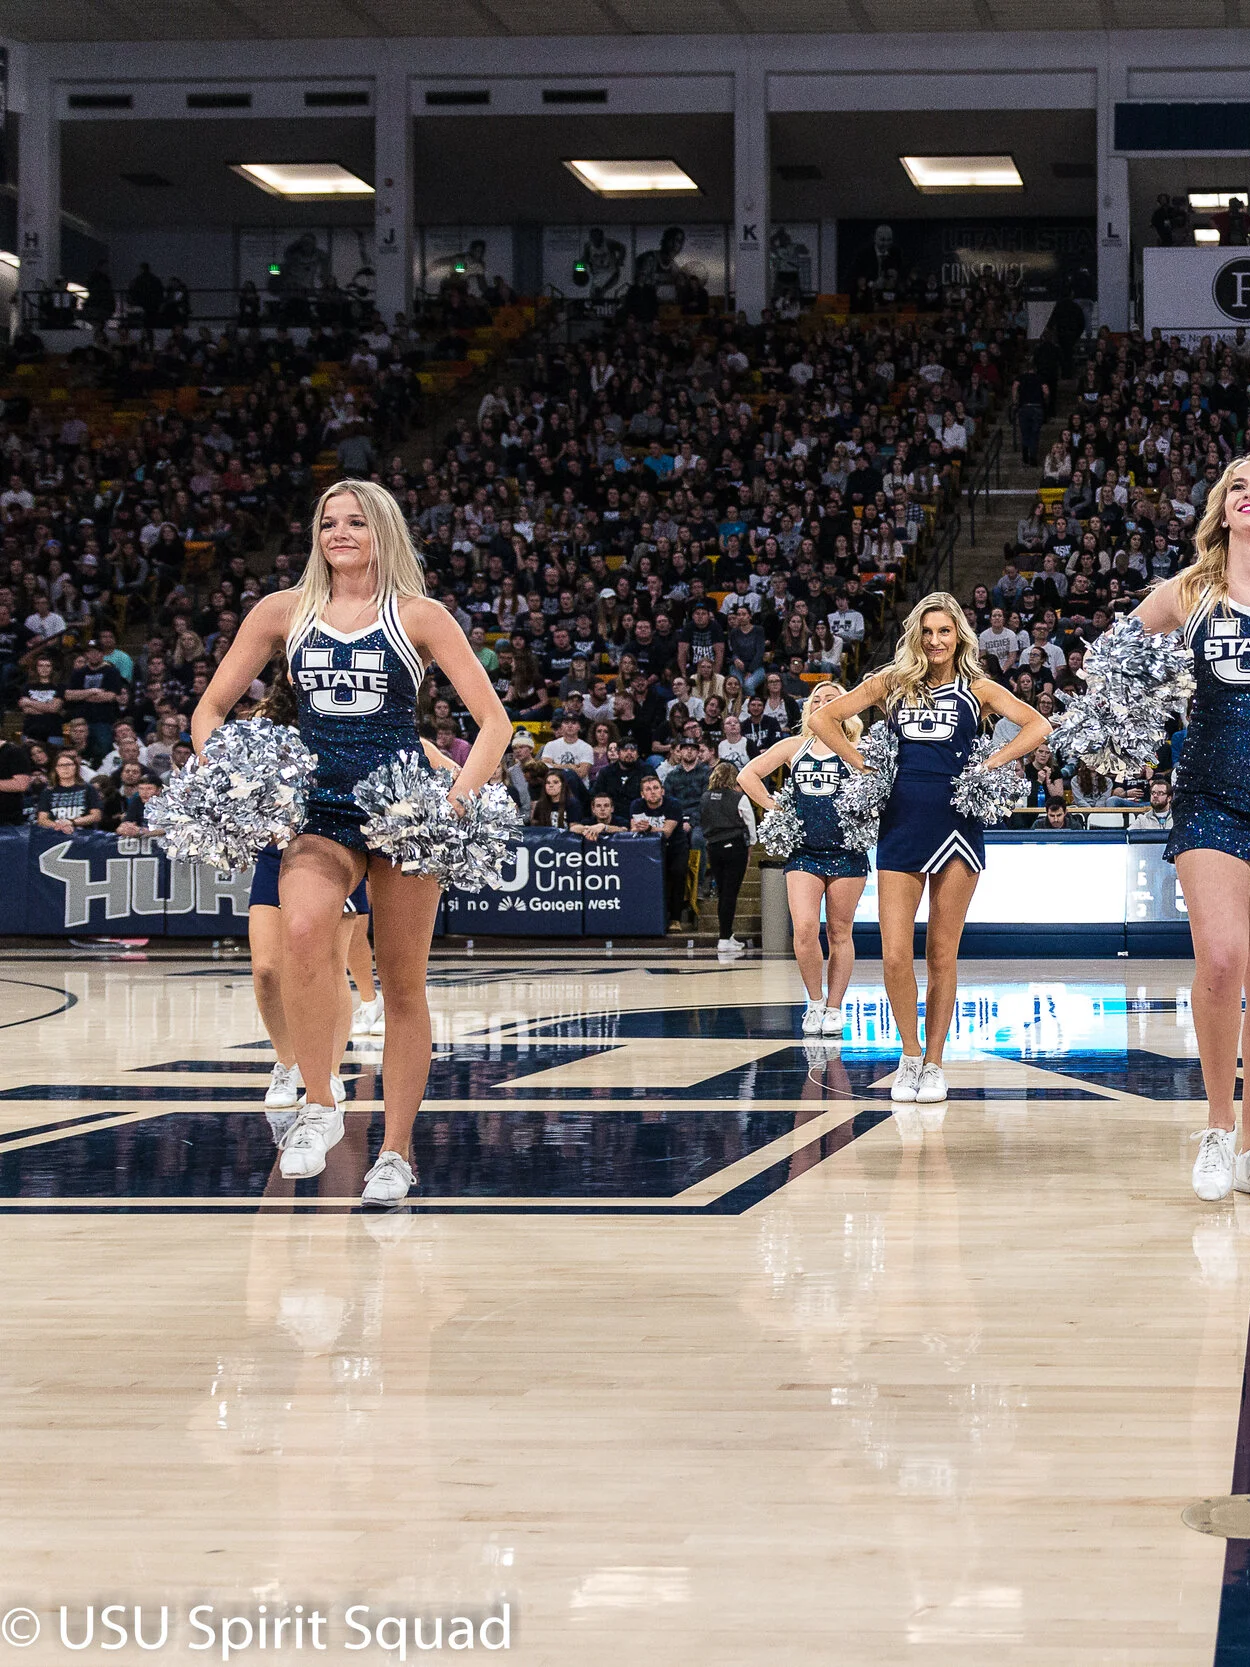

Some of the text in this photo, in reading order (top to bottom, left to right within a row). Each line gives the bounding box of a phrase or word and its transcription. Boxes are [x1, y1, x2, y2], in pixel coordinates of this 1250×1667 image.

[384, 228, 396, 244] J
[743, 224, 757, 240] K
[1107, 222, 1119, 238] L
[24, 231, 38, 248] H
[297, 669, 389, 693] STATE
[897, 709, 959, 727] STATE
[795, 771, 840, 785] STATE
[534, 846, 619, 869] Credit
[535, 871, 621, 893] Union
